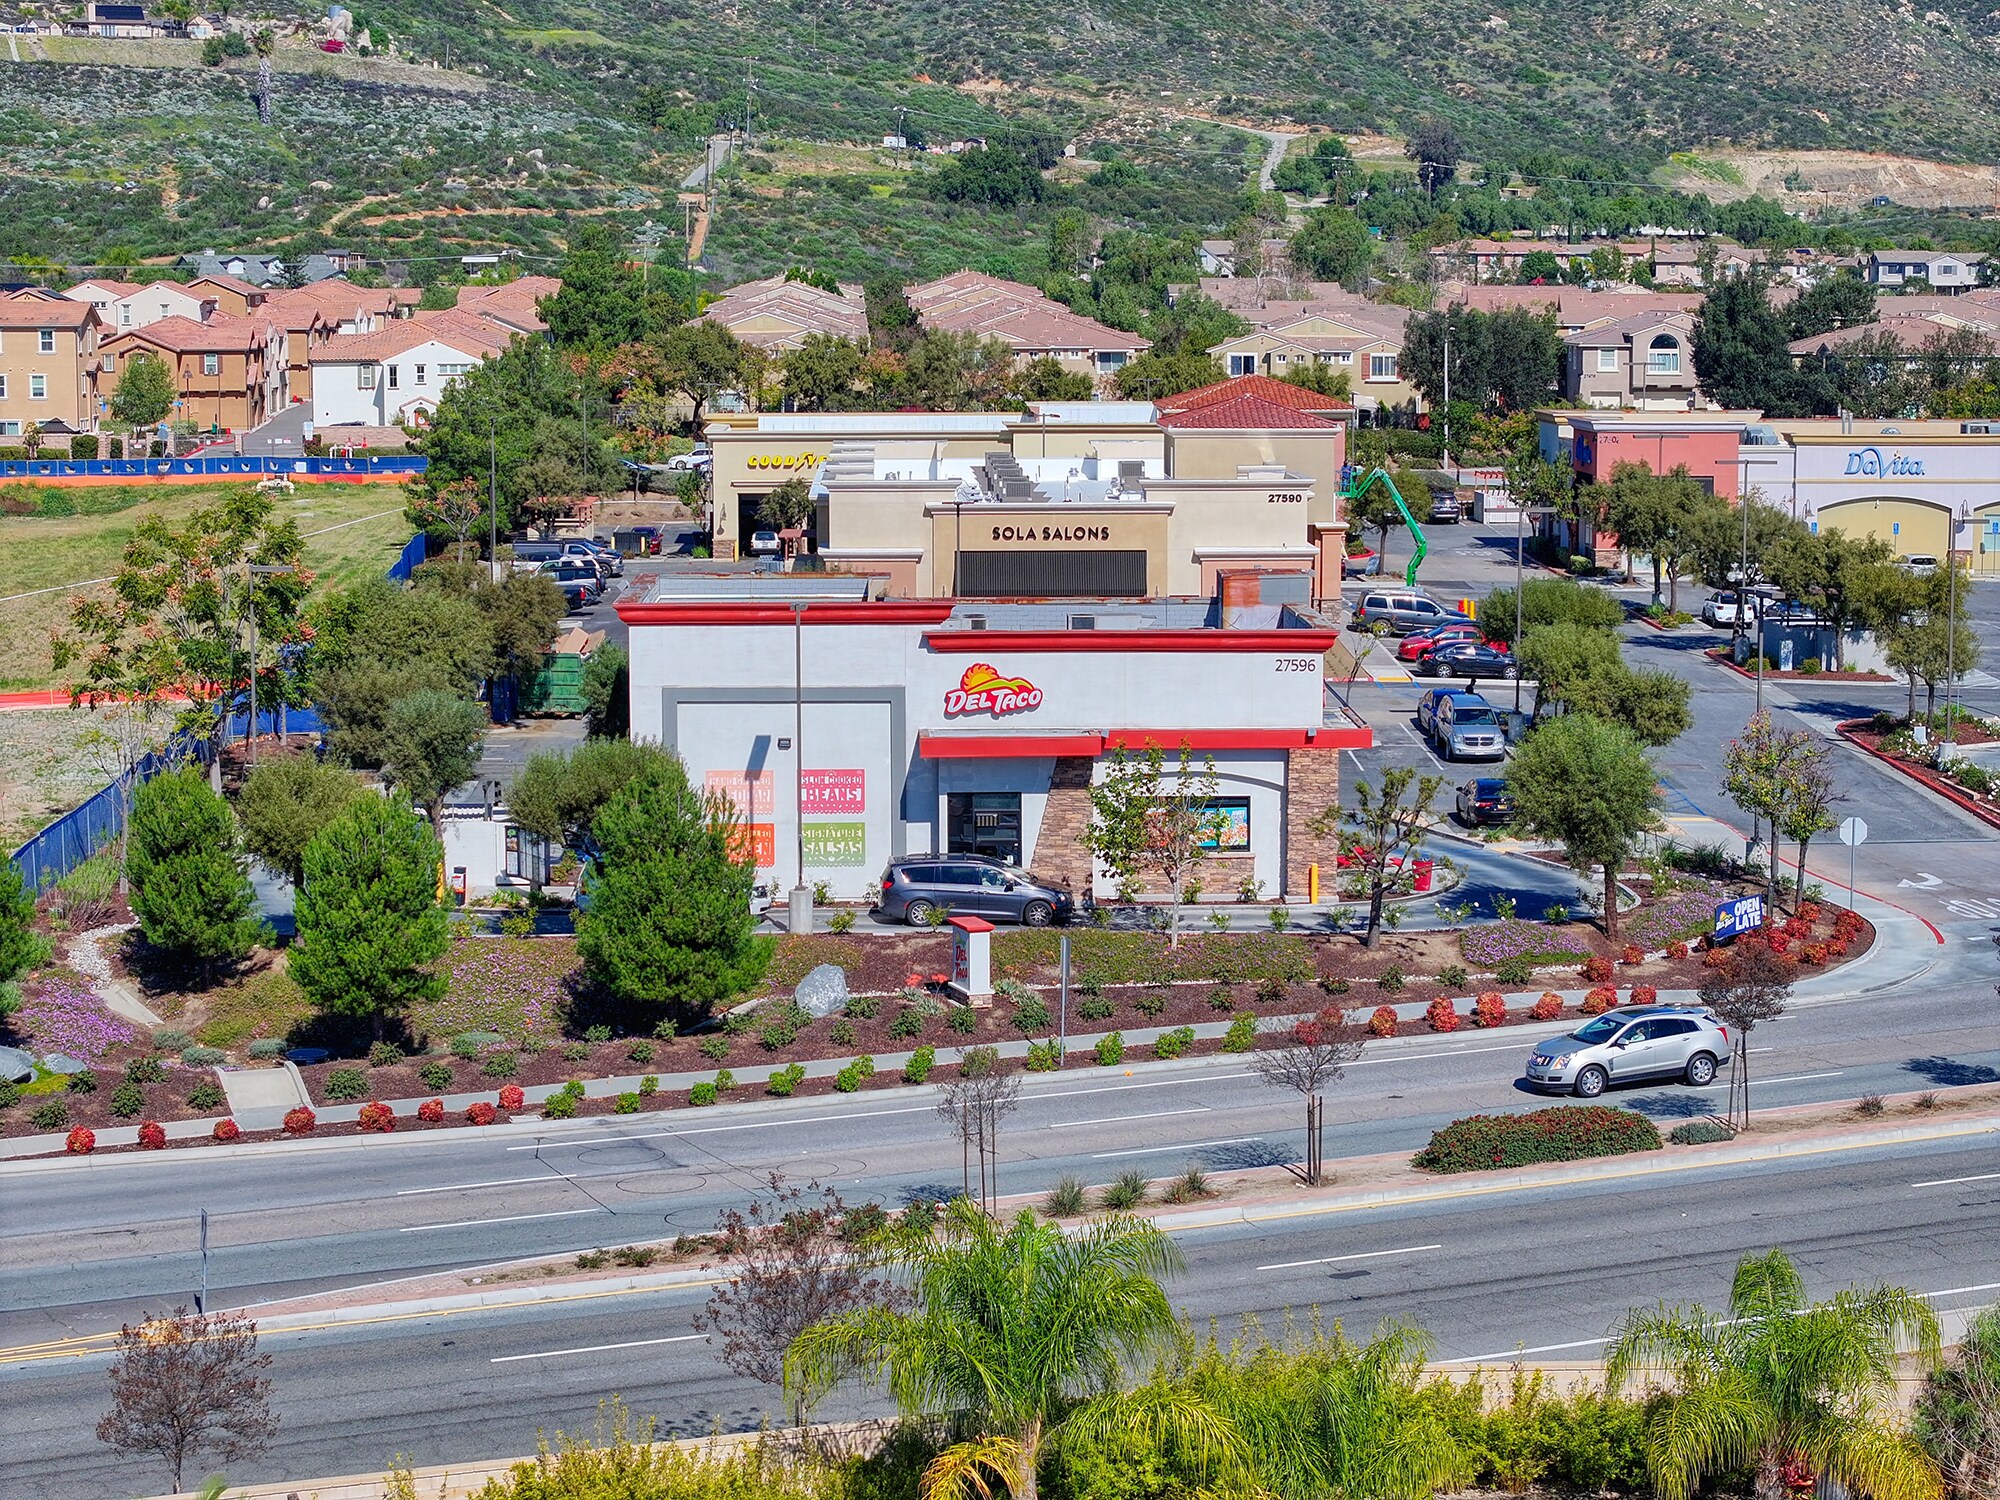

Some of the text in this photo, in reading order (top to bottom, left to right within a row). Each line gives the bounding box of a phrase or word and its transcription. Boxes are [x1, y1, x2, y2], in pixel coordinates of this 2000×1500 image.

[1268, 494, 1303, 503] 27590
[992, 526, 1109, 541] SOLA SALONS
[1275, 659, 1316, 672] 27596
[806, 788, 858, 801] BEANS
[802, 829, 862, 838] SIGNATURE
[802, 842, 862, 854] SALSAS
[1734, 896, 1760, 916] OPEN
[1735, 910, 1761, 930] LATE
